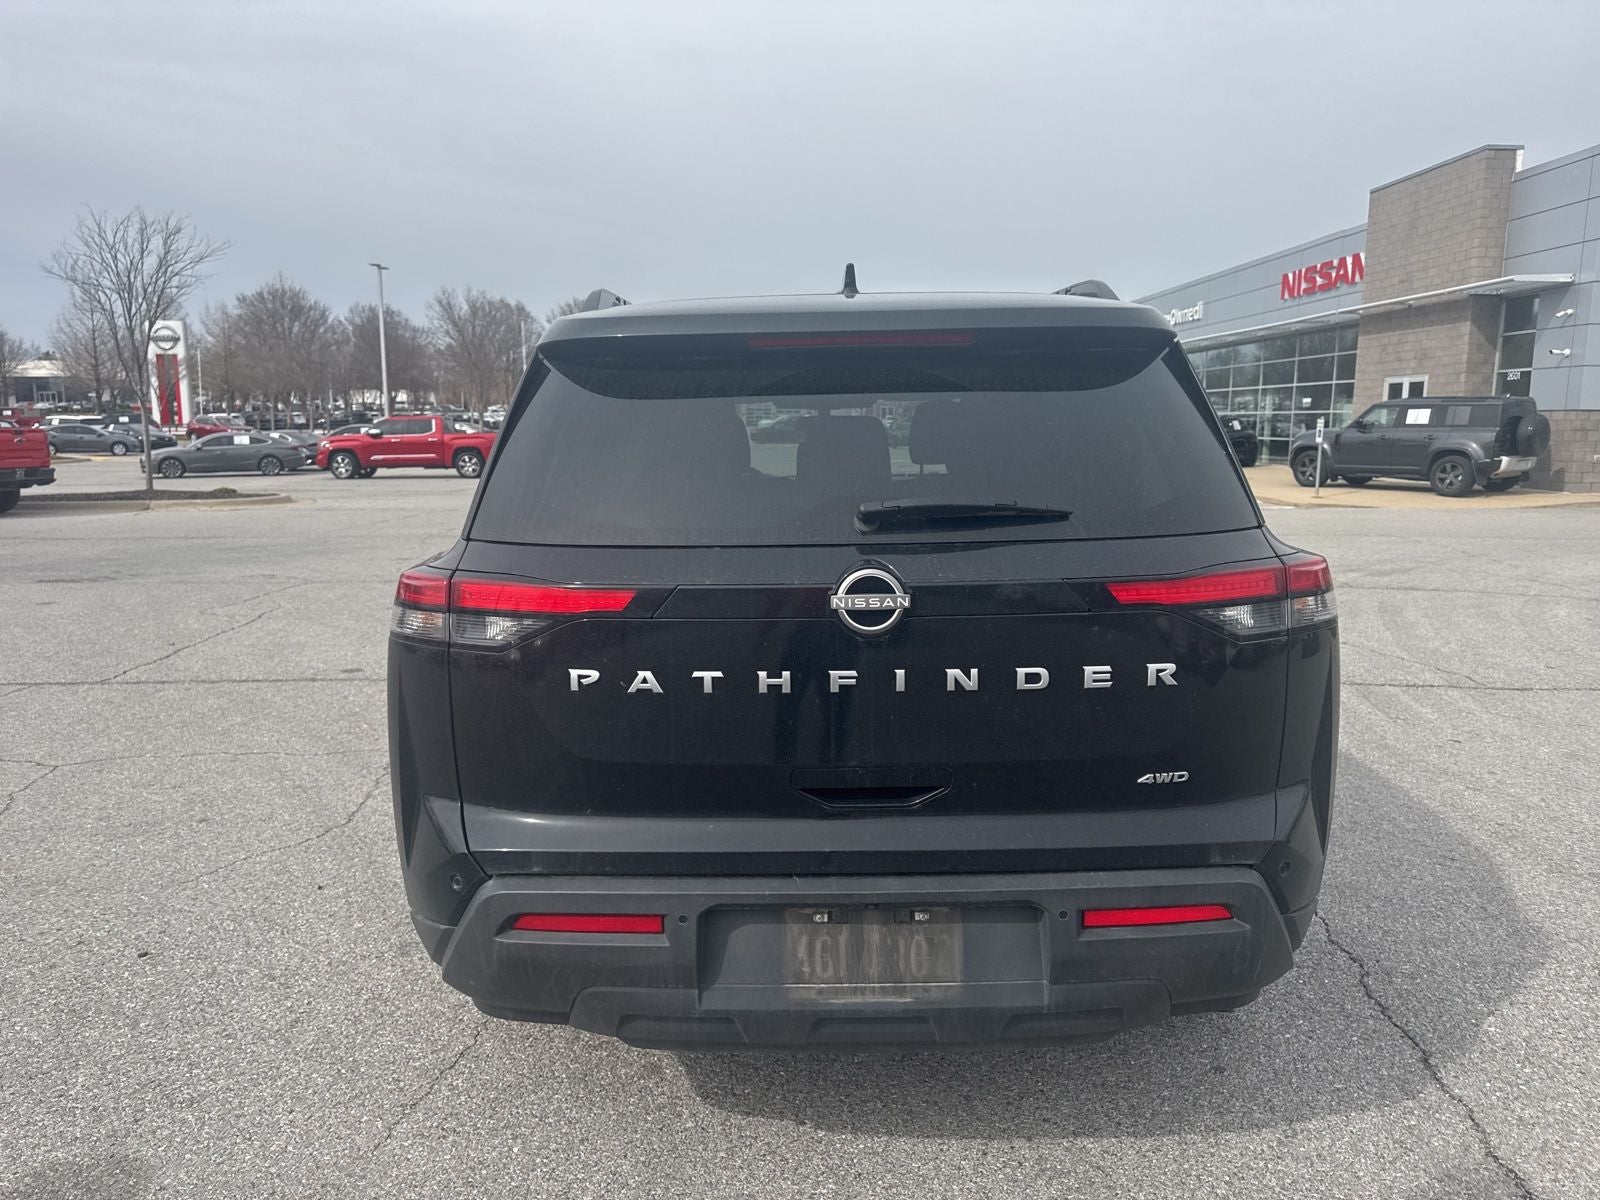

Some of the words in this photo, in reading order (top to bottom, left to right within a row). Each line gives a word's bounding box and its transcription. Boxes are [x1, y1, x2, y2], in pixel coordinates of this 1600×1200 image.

[1281, 252, 1364, 300] NISSAN
[833, 597, 909, 608] NISSAN
[568, 663, 1179, 694] PATHFINDER
[1137, 771, 1190, 784] 4WD
